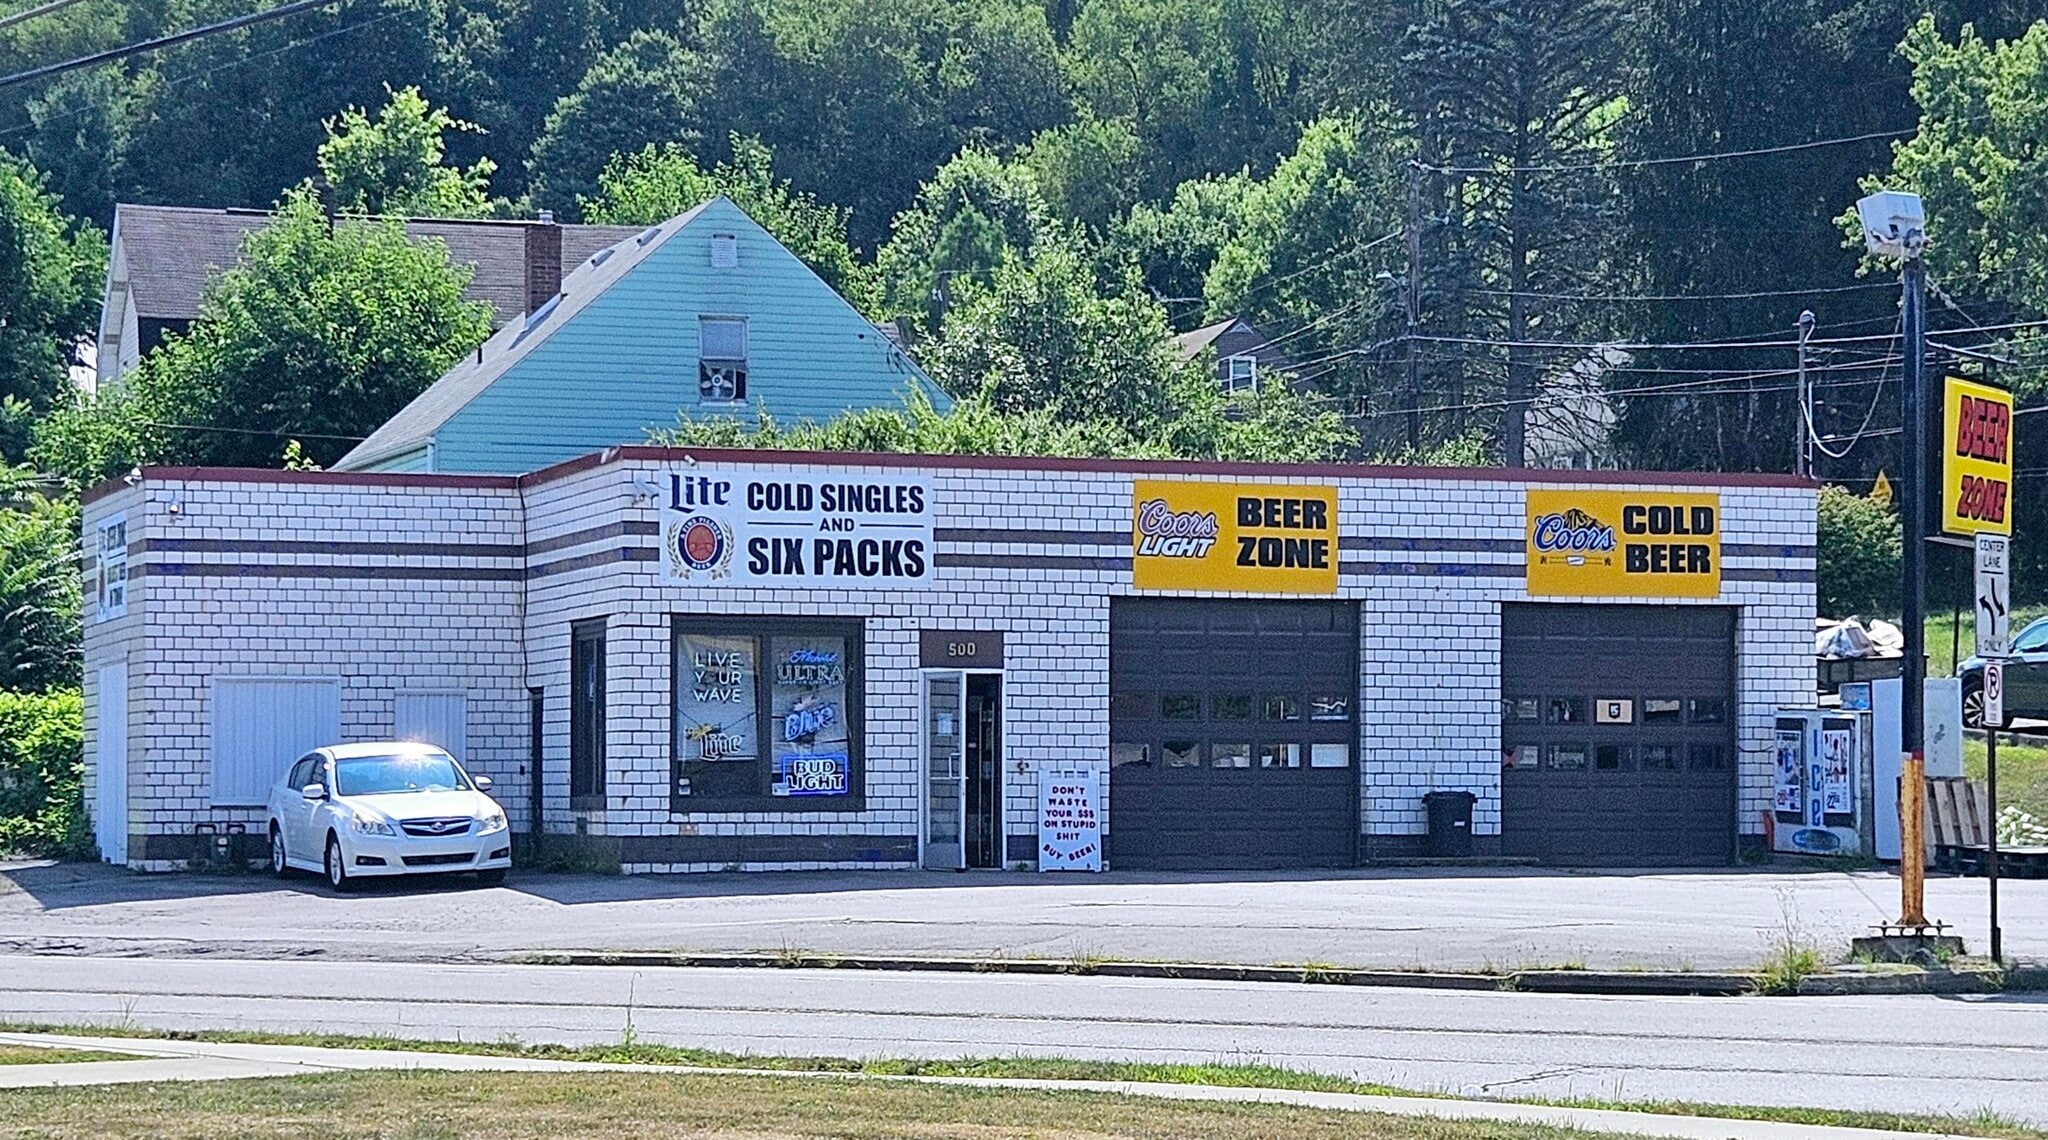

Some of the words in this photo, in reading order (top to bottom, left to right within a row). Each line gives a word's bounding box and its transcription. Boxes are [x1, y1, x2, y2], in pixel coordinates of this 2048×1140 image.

[1957, 394, 2010, 465] BEER
[668, 474, 731, 514] Lite
[747, 482, 813, 511] COLD
[820, 485, 924, 514] SINGLES
[1957, 475, 2008, 524] ZONE
[1139, 500, 1217, 537] Coors
[1237, 497, 1327, 529] BEER
[1622, 505, 1714, 535] COLD
[819, 518, 855, 532] AND
[1534, 514, 1616, 552] Coors
[1138, 536, 1214, 557] LIGHT
[1236, 536, 1329, 569] ZONE
[1979, 539, 2005, 552] CENTER
[749, 537, 804, 575] SIX
[813, 539, 925, 578] PACKS
[1625, 544, 1711, 573] BEER
[1983, 555, 2001, 568] LANE
[948, 642, 976, 656] 500
[1984, 639, 2002, 652] ONLY
[695, 652, 741, 668] LIVE
[777, 664, 845, 681] ULTRA
[693, 687, 742, 702] WAVE
[785, 706, 834, 741] Blue
[793, 759, 836, 776] BUD
[786, 774, 844, 791] LIGHT
[1811, 729, 1821, 827] Ice
[1052, 785, 1085, 795] DON'T
[1048, 798, 1087, 807] WASTE
[1045, 809, 1072, 818] YOUR
[1044, 819, 1058, 828] ON
[1061, 820, 1096, 829] STUPID
[1056, 832, 1080, 841] SHIT
[1043, 843, 1063, 860] BUY
[1068, 842, 1097, 861] BEER!
